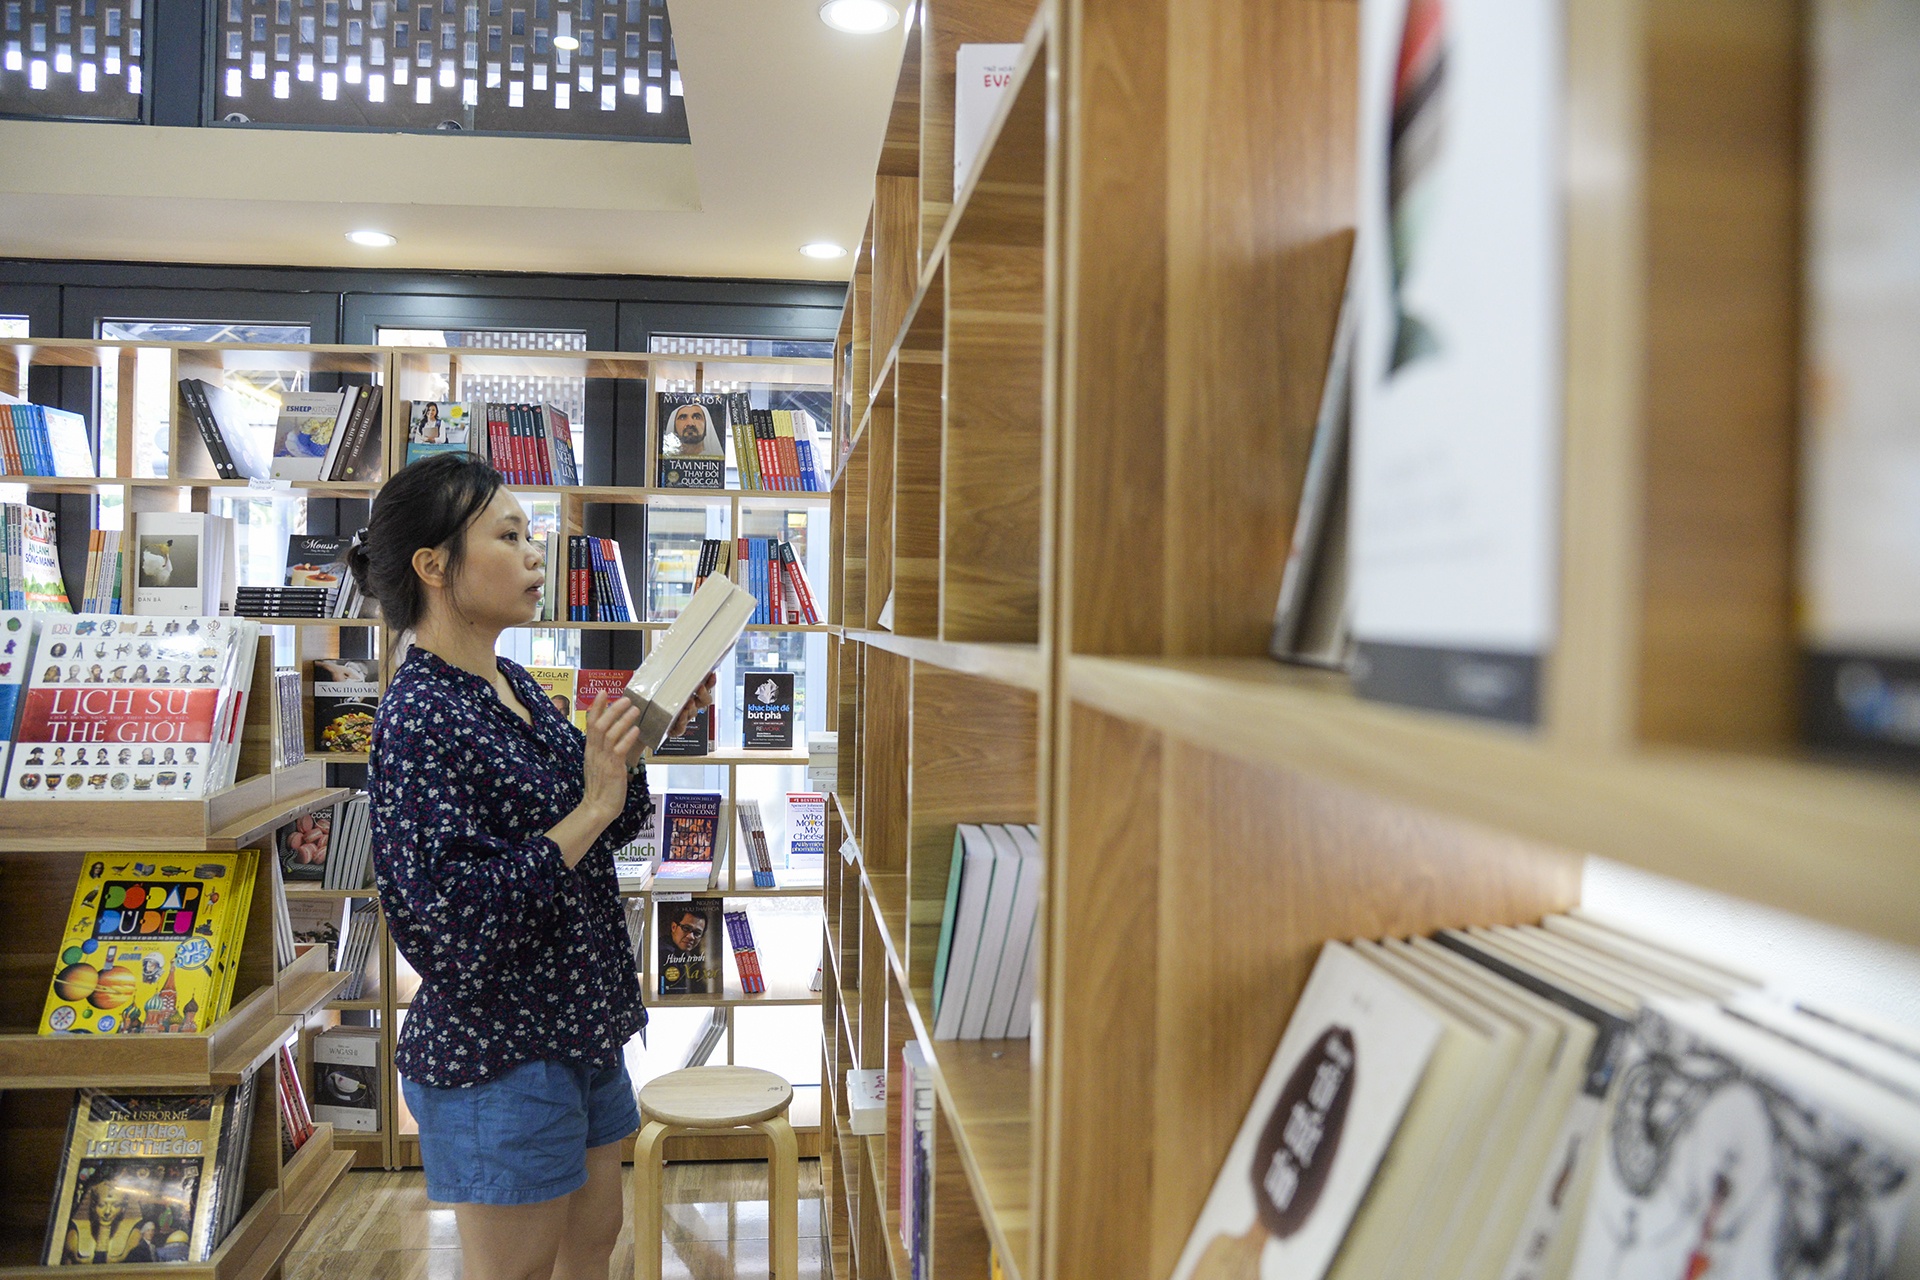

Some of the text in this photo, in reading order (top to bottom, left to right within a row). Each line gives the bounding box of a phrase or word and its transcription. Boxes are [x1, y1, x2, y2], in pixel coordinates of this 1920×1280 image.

[685, 396, 722, 404] VISION
[312, 406, 338, 414] KITCHEN
[301, 539, 339, 550] Mousse
[608, 686, 625, 694] MÌN
[51, 690, 136, 716] LỊCH
[47, 719, 186, 742] THẾ GIỚI
[671, 832, 712, 846] GROW
[669, 846, 711, 860] RICH
[176, 939, 206, 956] QUIZ
[175, 946, 213, 968] QUEST
[110, 1110, 188, 1120] The USBORNE
[146, 1124, 187, 1138] KHOA
